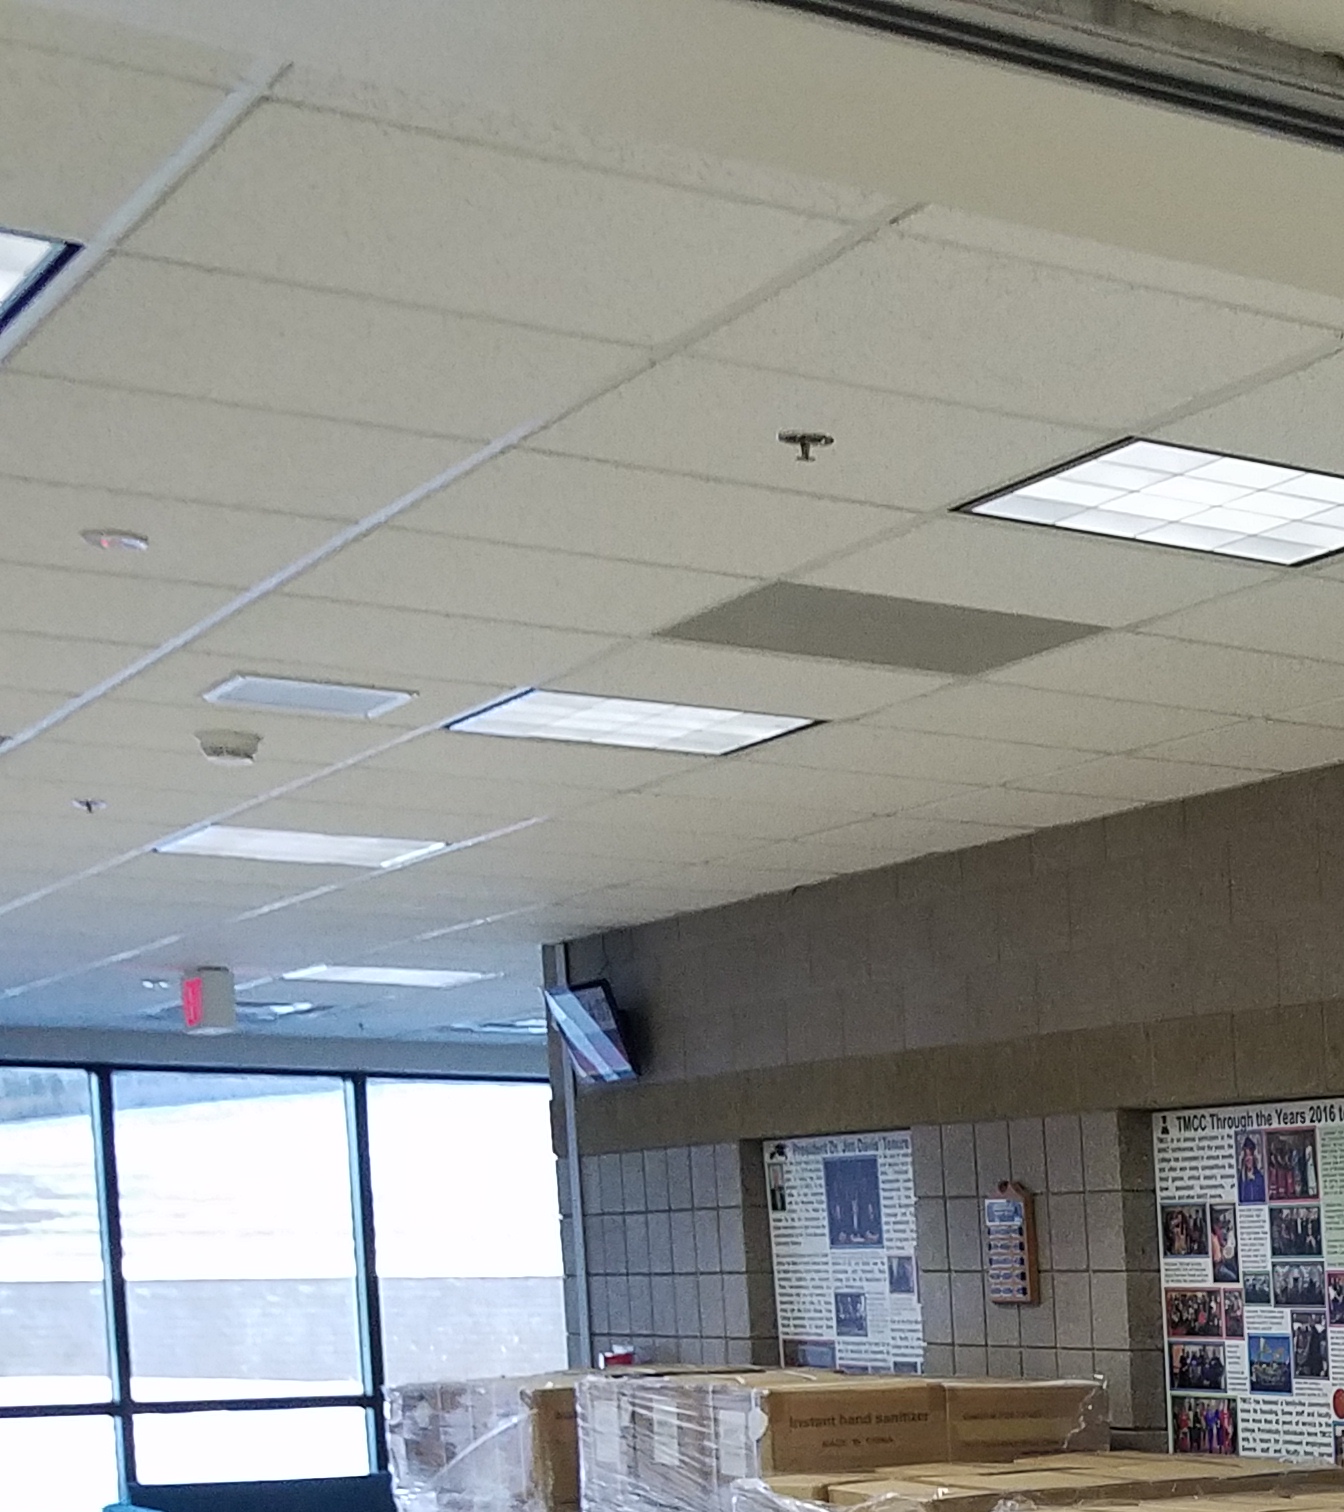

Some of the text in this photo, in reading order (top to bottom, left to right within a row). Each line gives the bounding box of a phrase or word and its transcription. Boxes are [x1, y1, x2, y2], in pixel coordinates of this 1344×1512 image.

[1176, 1114, 1207, 1132] TMCC
[1210, 1110, 1254, 1131] Through
[1256, 1110, 1272, 1126] the
[1275, 1108, 1306, 1125] Years
[1309, 1105, 1335, 1124] 2016
[790, 1412, 928, 1429] Instant hand sanitizer
